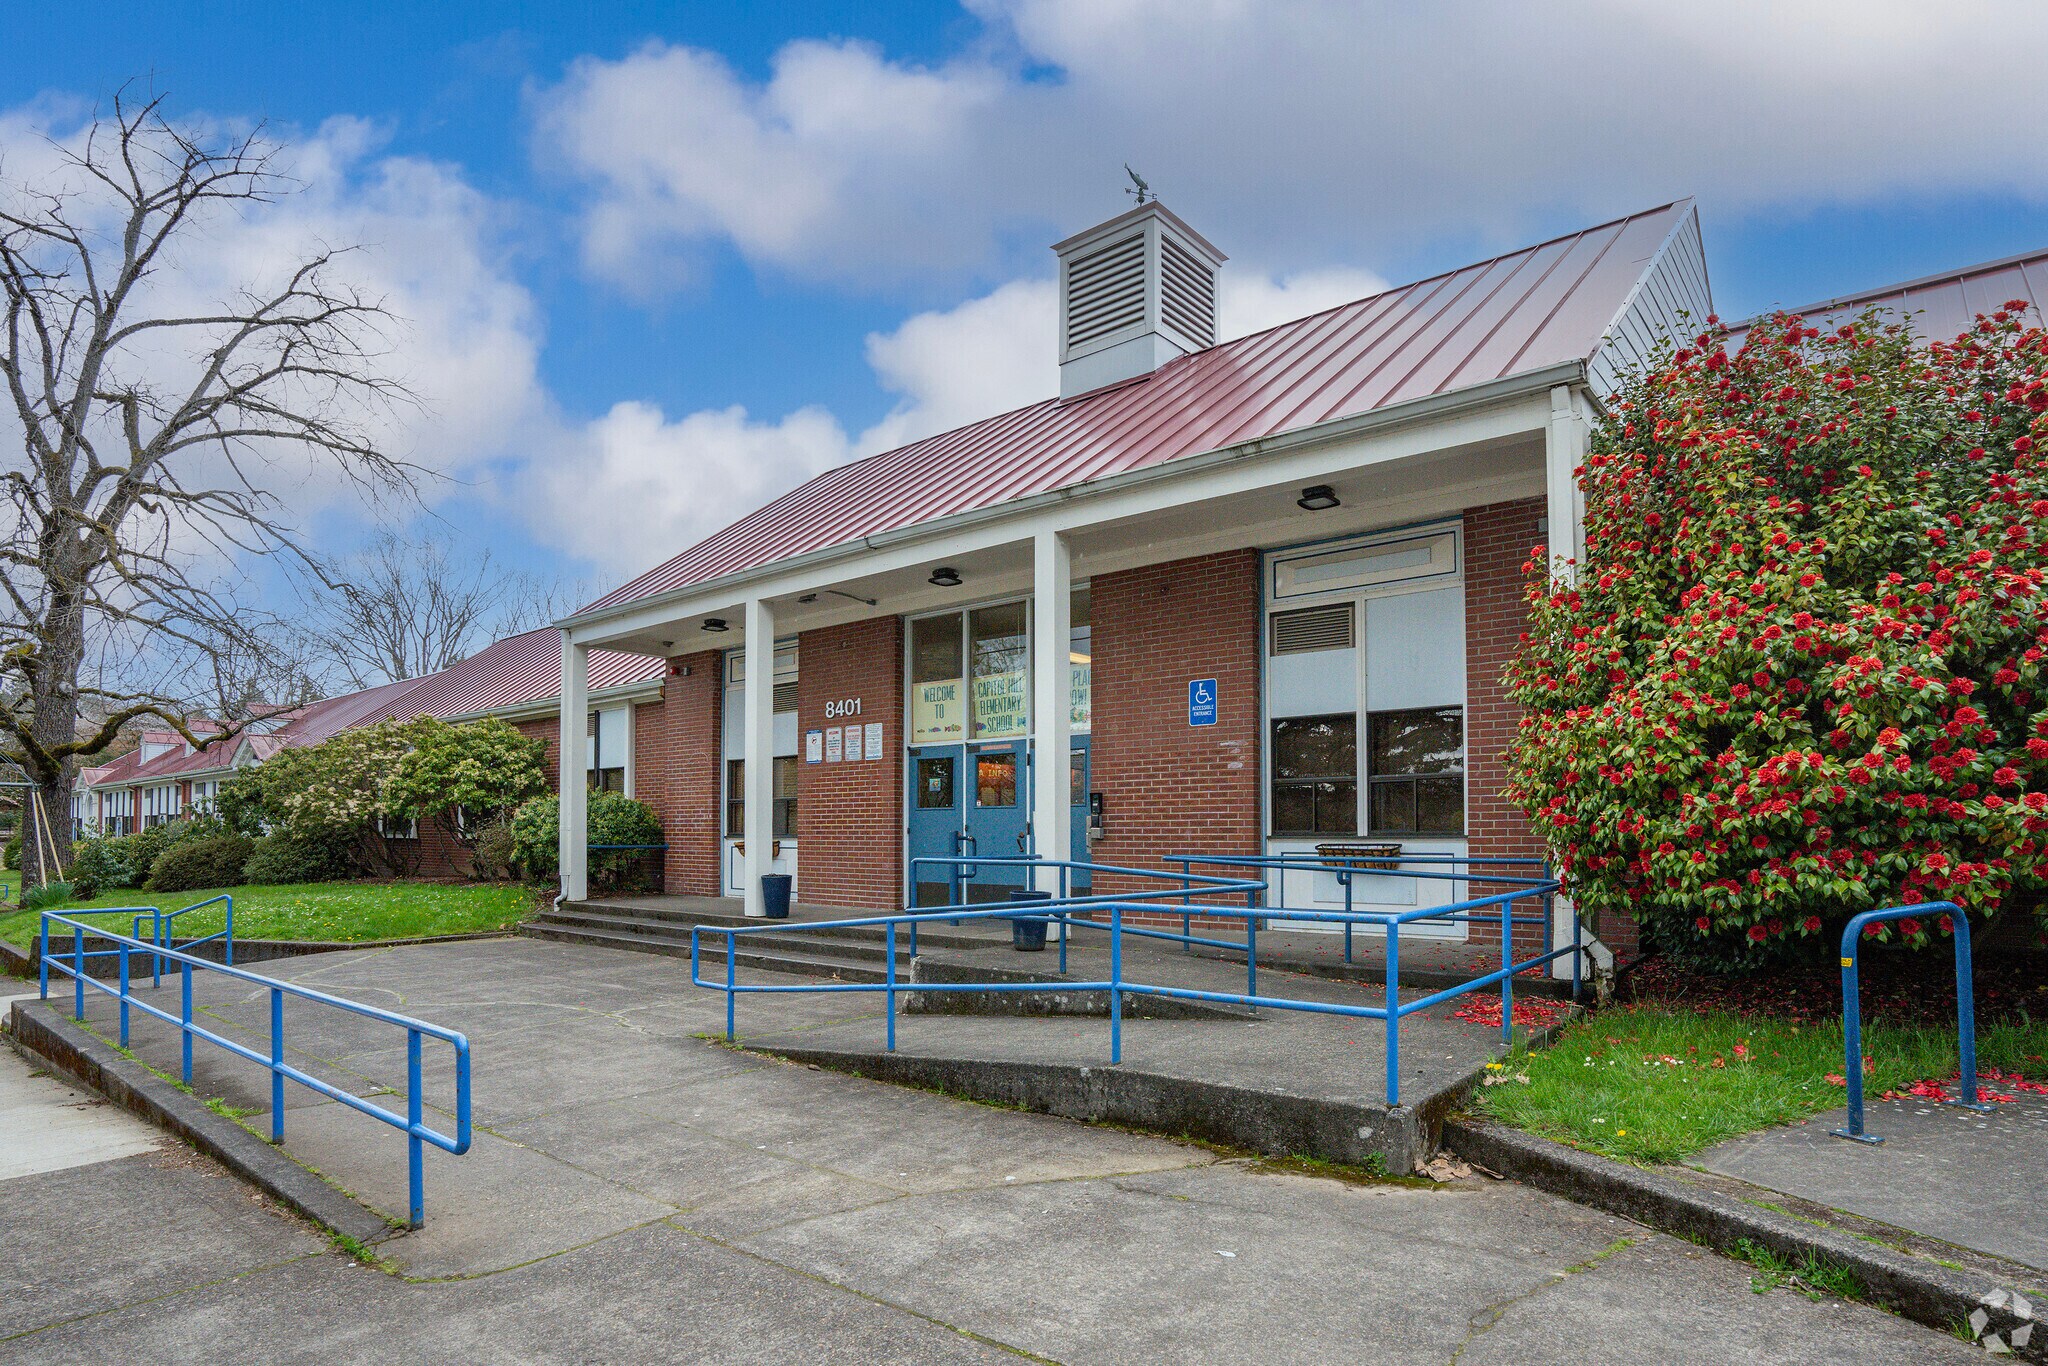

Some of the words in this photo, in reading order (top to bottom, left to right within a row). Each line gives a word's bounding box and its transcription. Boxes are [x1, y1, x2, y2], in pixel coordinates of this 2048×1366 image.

[924, 684, 955, 702] WELCOME
[978, 679, 1006, 698] CAPITOL
[1008, 676, 1023, 693] HILL
[825, 697, 861, 718] 8401
[935, 703, 945, 719] TO
[980, 694, 1021, 715] ELEMENTARY
[987, 714, 1013, 733] SCHOOL
